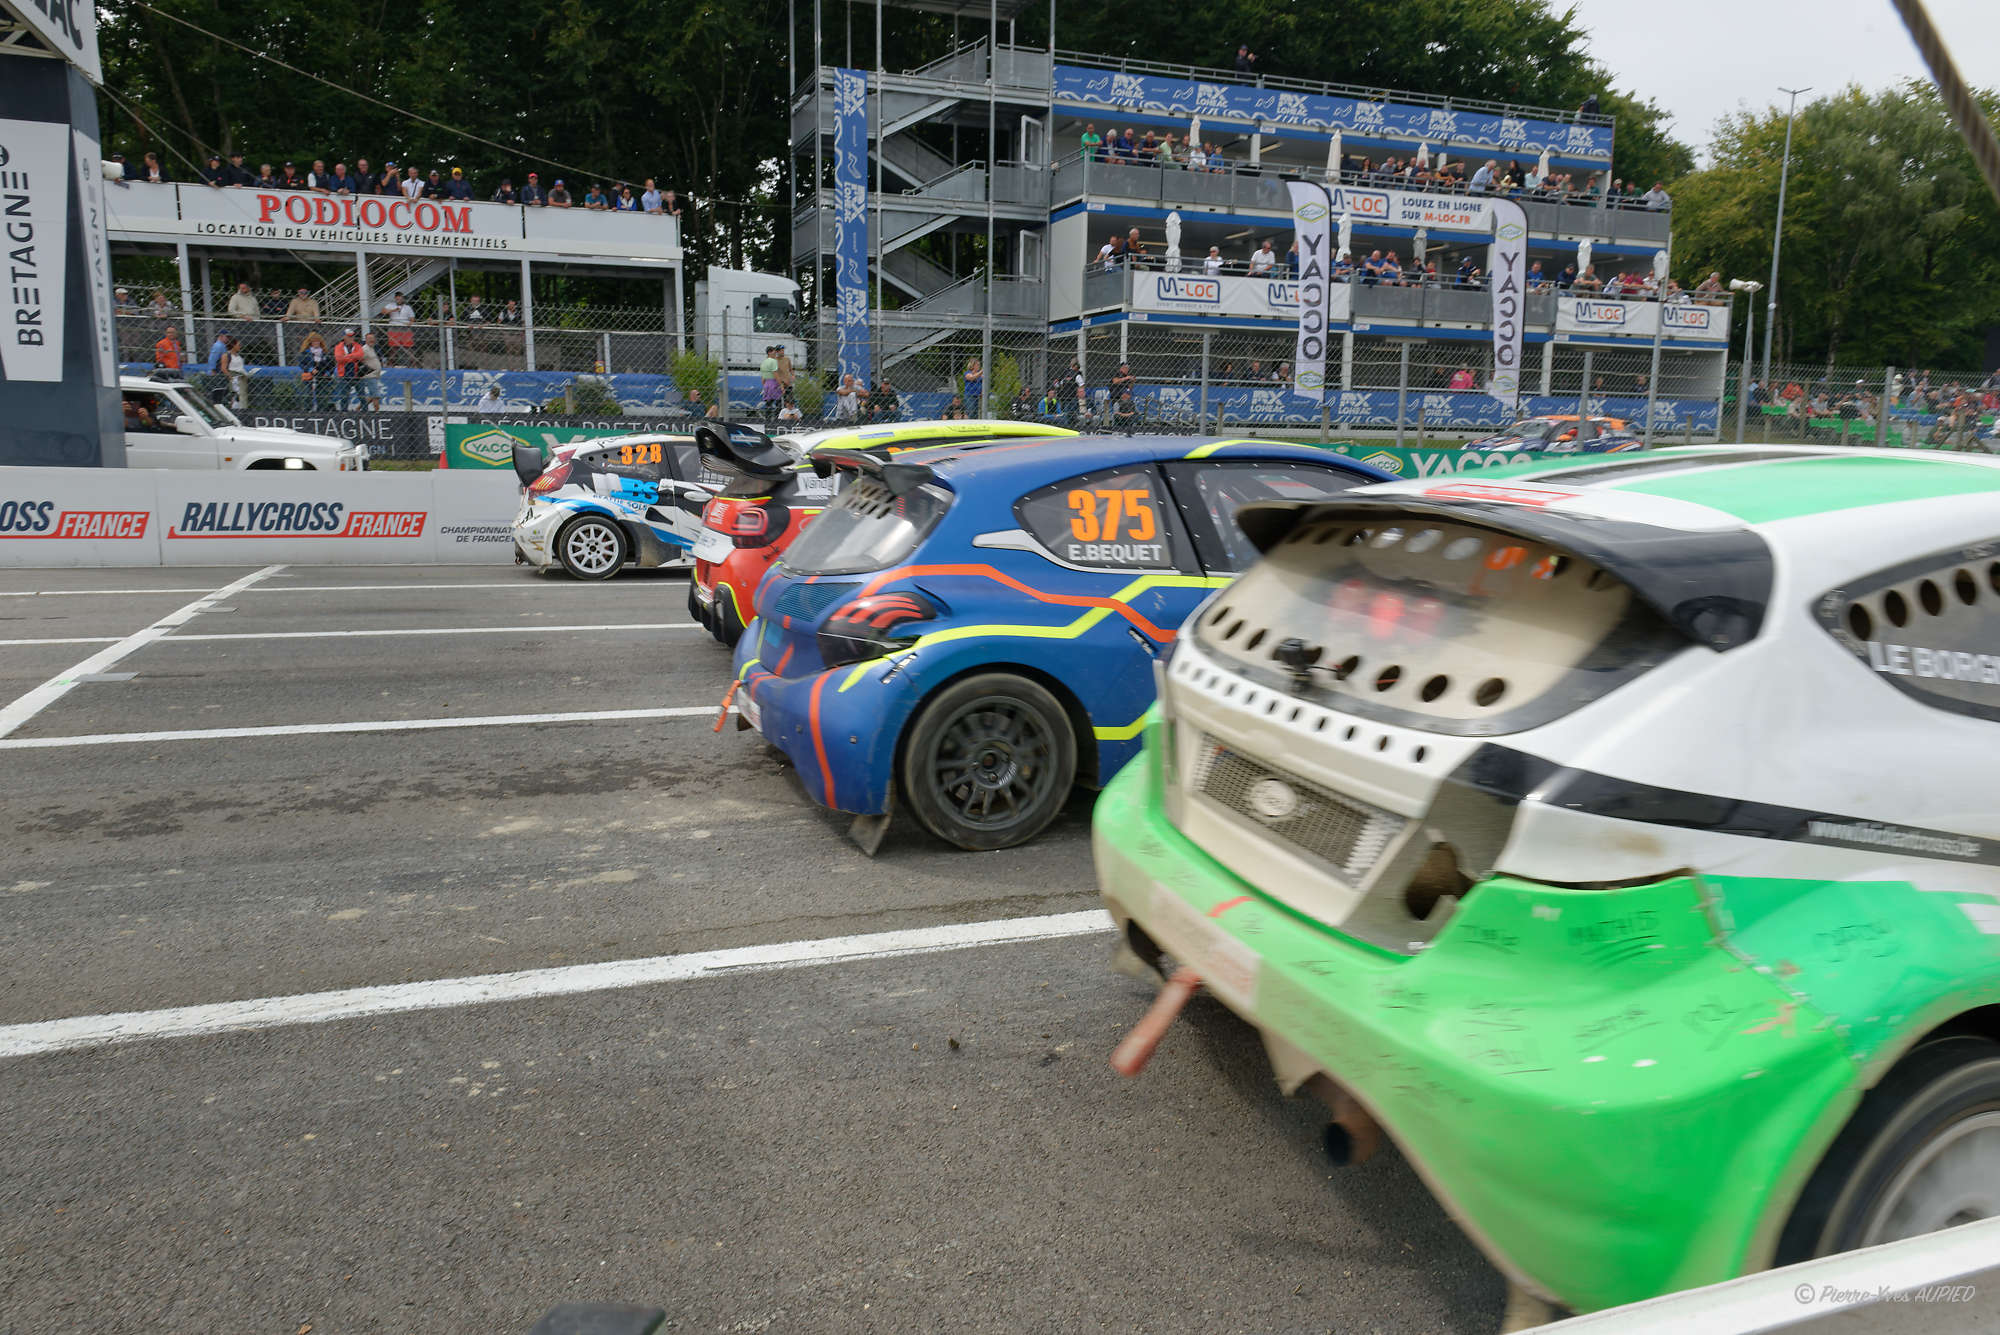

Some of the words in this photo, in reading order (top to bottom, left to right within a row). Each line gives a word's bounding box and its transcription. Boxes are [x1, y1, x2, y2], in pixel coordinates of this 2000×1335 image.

[256, 194, 473, 233] PODIOCOM
[1402, 197, 1433, 208] LOUEZ
[1438, 200, 1450, 210] EN
[1453, 202, 1482, 212] LIGNE
[1401, 210, 1420, 220] SUR
[1424, 212, 1471, 225] M-LOC.FR
[197, 223, 276, 237] LOCATION
[285, 227, 303, 238] DE
[2, 171, 44, 347] BRETAGNE
[1158, 276, 1215, 298] M-LOC
[1576, 302, 1621, 321] M-LOC
[1663, 306, 1705, 325] M-LOC
[621, 443, 662, 465] 328
[60, 513, 146, 537] FRANCE
[180, 502, 344, 531] RALLYCROSS
[348, 514, 425, 536] FRANCE
[1067, 489, 1156, 542] 375
[441, 526, 512, 535] CHAMPIONNAT
[456, 535, 469, 543] DE
[472, 535, 511, 543] FRANCE
[1068, 544, 1161, 564] E.BEQUET
[1867, 641, 1913, 676] LE
